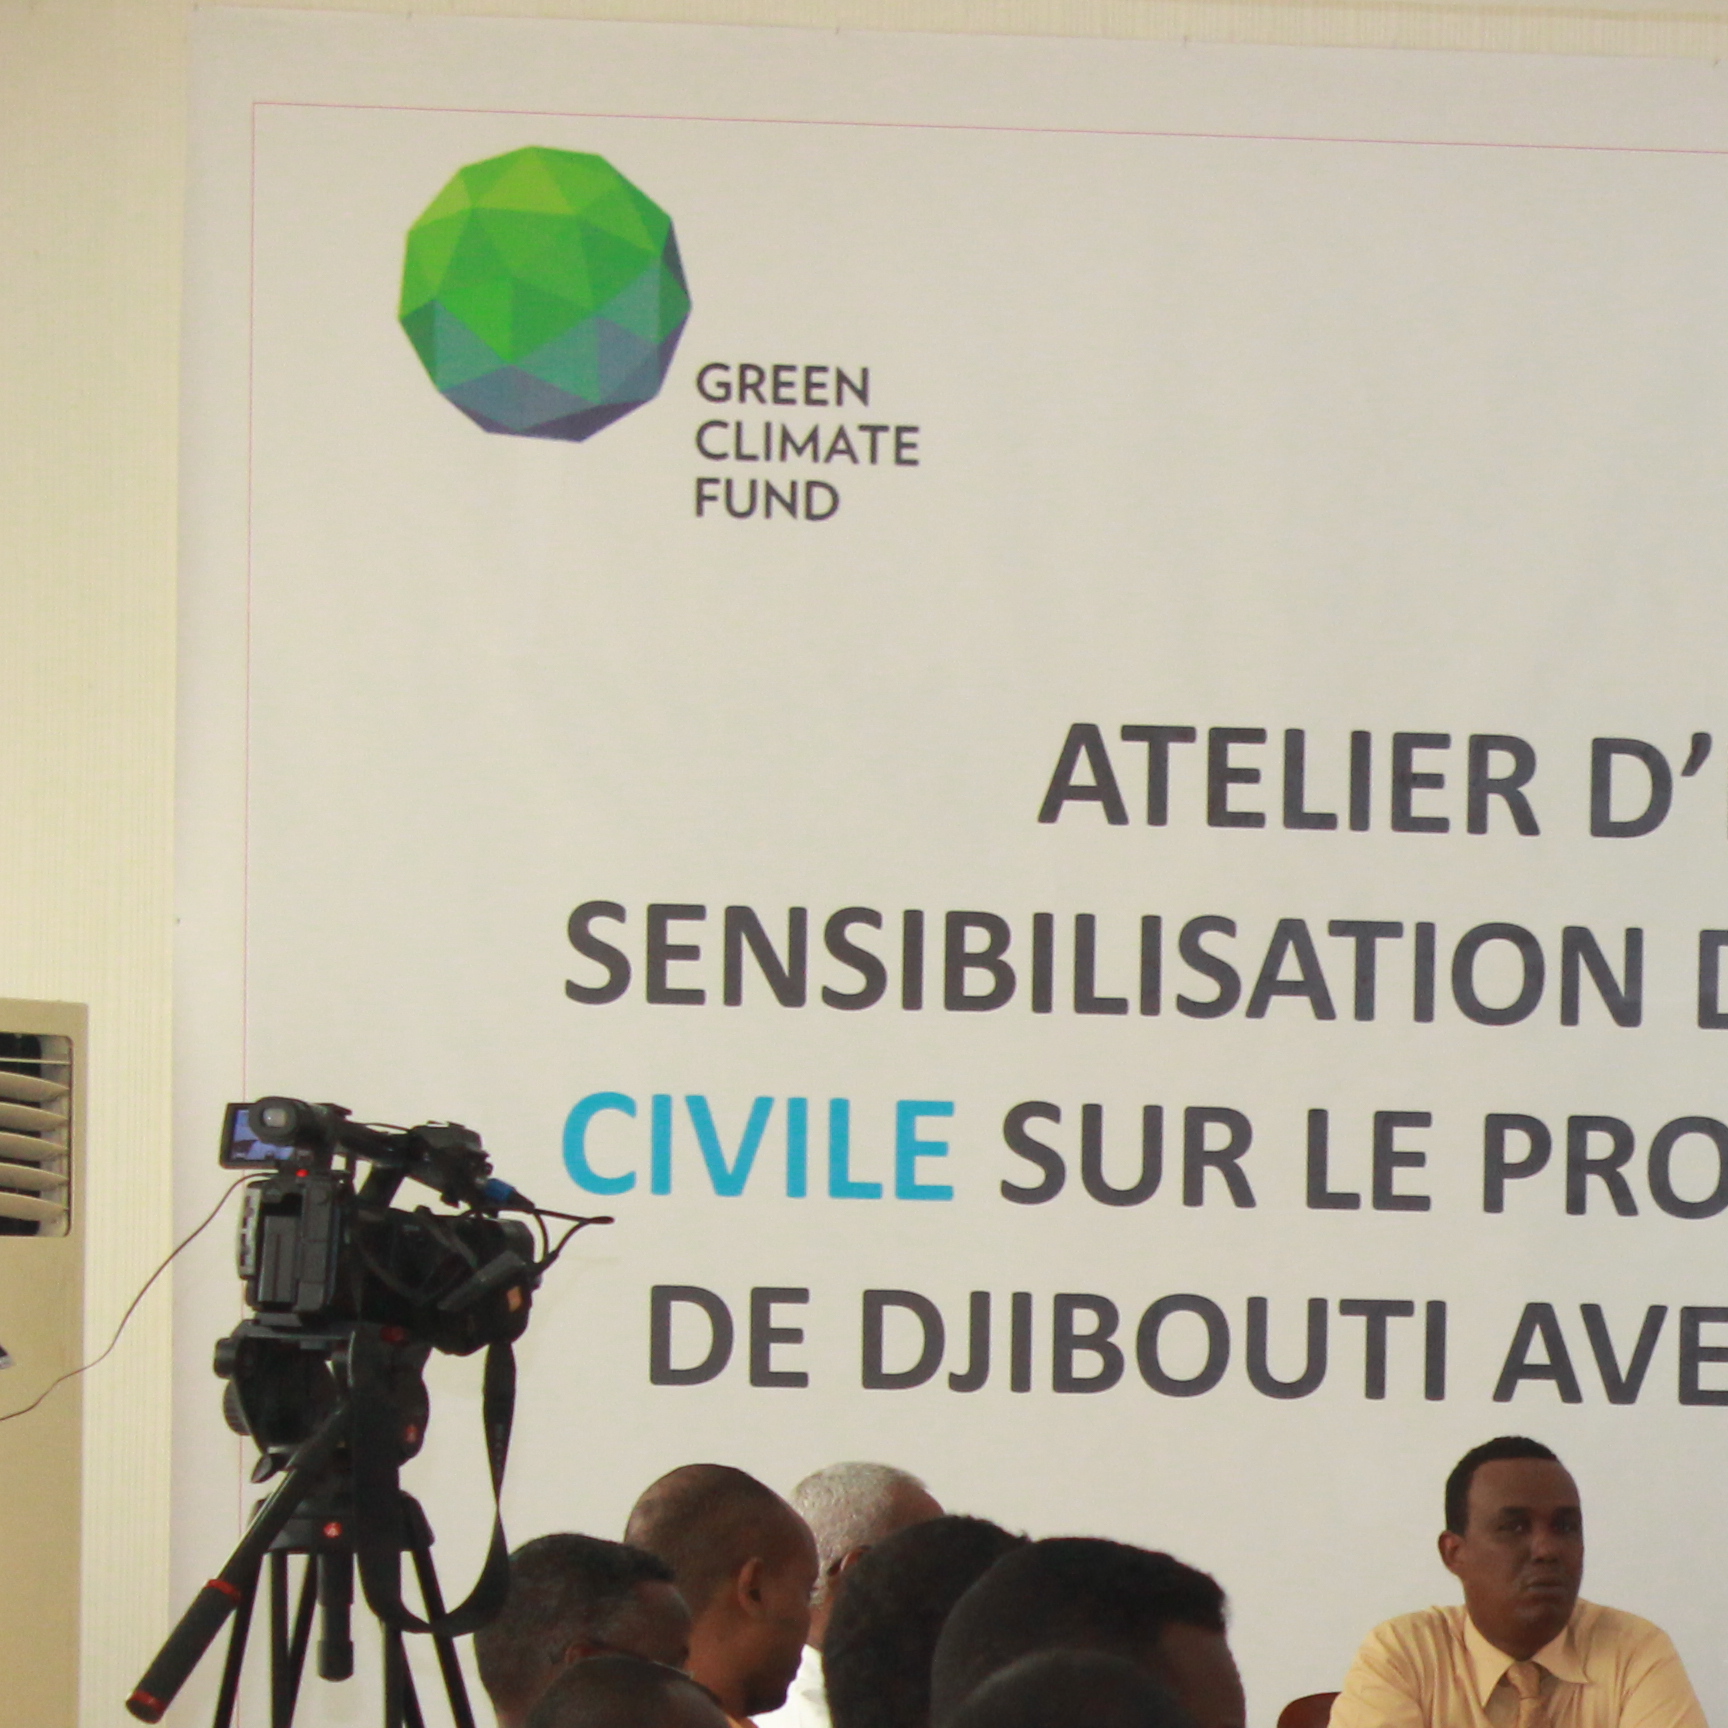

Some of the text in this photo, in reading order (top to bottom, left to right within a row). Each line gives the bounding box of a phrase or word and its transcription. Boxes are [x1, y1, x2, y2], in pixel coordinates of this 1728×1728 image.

[694, 361, 870, 408] GREEN
[694, 418, 920, 467] CLIMATE
[694, 476, 841, 522] FUND
[1036, 722, 1541, 837] ATELIER
[564, 899, 1645, 1028] SENSIBILISATION
[562, 1091, 956, 1201] CIVILE
[998, 1099, 1257, 1210] SUR
[1304, 1107, 1433, 1212] LE
[647, 1284, 811, 1389] DE
[859, 1288, 1448, 1403] DJIBOUTI
